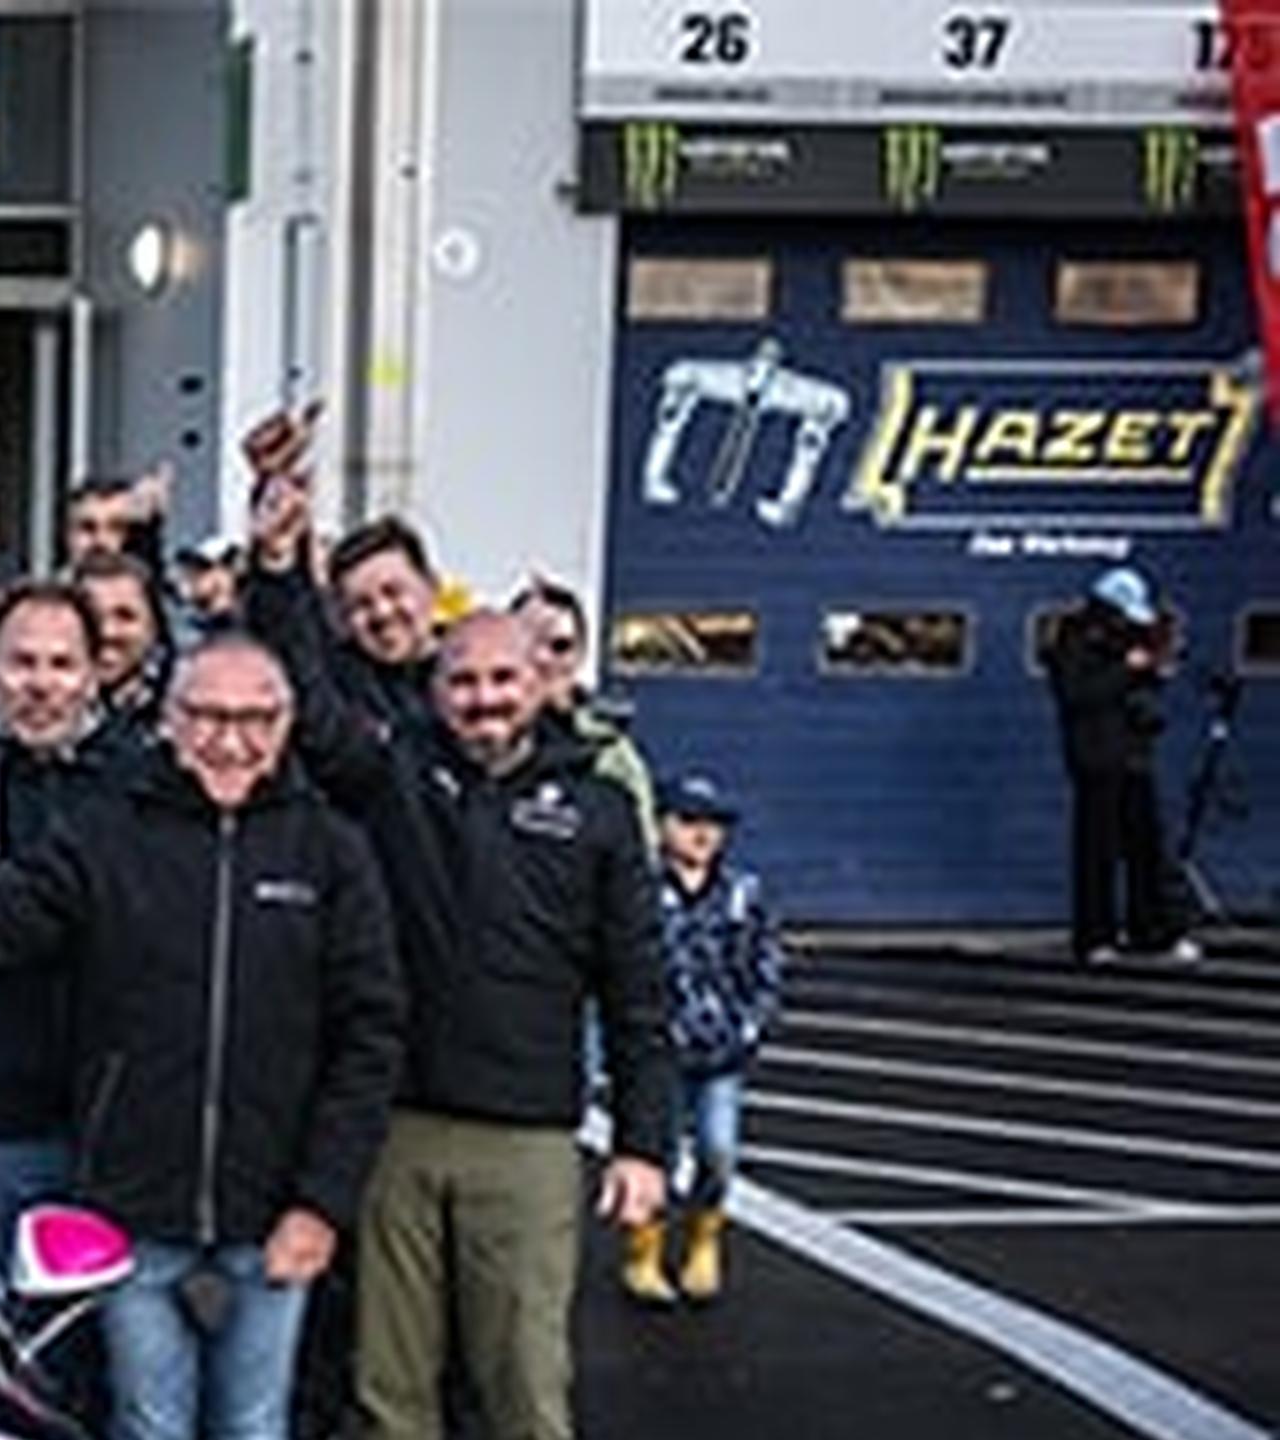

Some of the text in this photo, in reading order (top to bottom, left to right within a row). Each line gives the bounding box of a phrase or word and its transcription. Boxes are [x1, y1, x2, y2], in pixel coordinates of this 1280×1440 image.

[682, 16, 749, 63] 26
[943, 19, 1009, 68] 37
[901, 406, 1217, 482] HAZET
